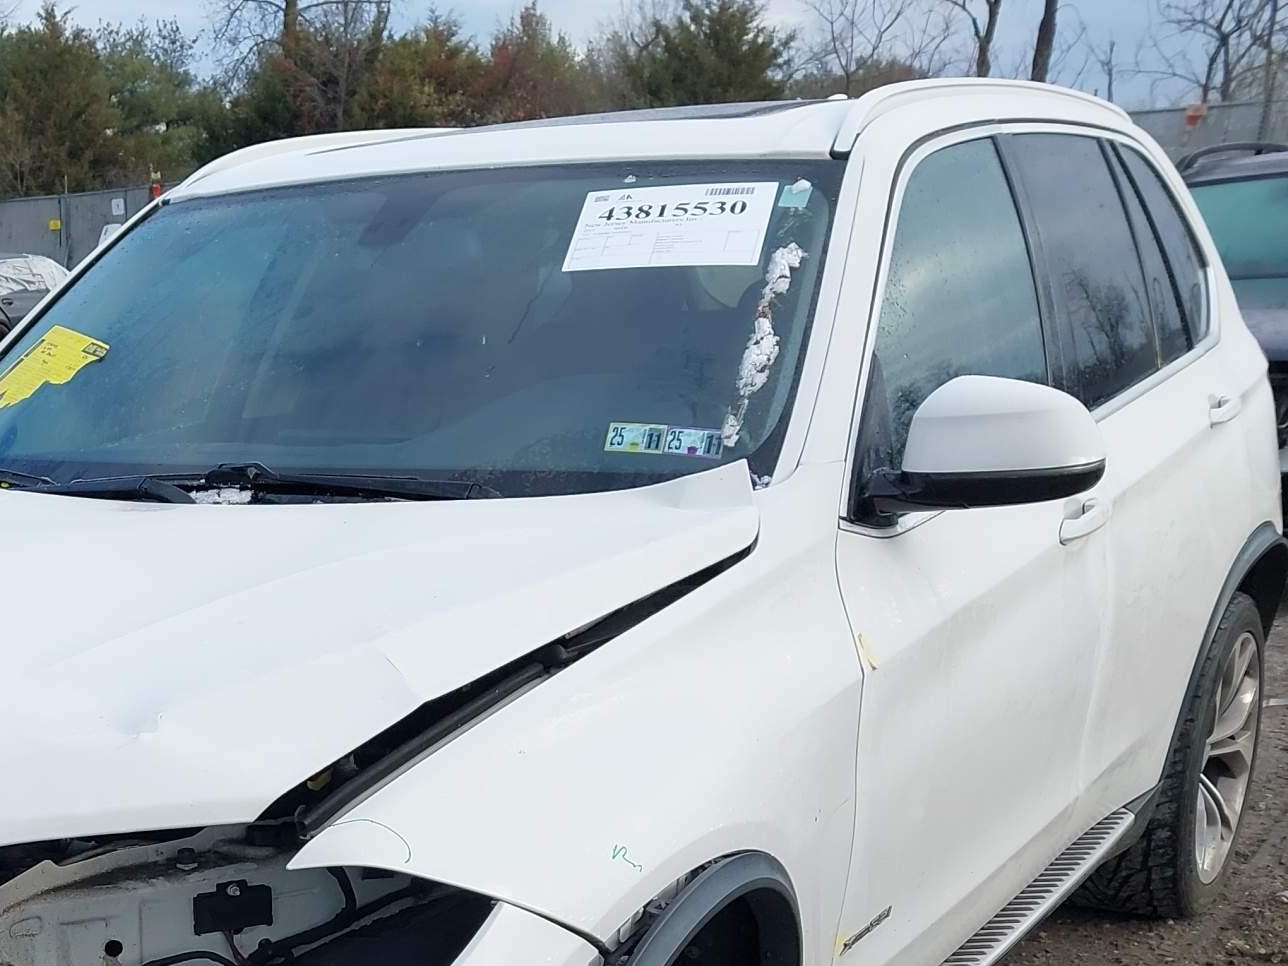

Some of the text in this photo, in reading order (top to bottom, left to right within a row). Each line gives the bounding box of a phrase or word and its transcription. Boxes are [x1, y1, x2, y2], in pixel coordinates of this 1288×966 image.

[599, 200, 747, 221] 43815530
[610, 427, 662, 449] 25 11
[668, 431, 683, 450] 25
